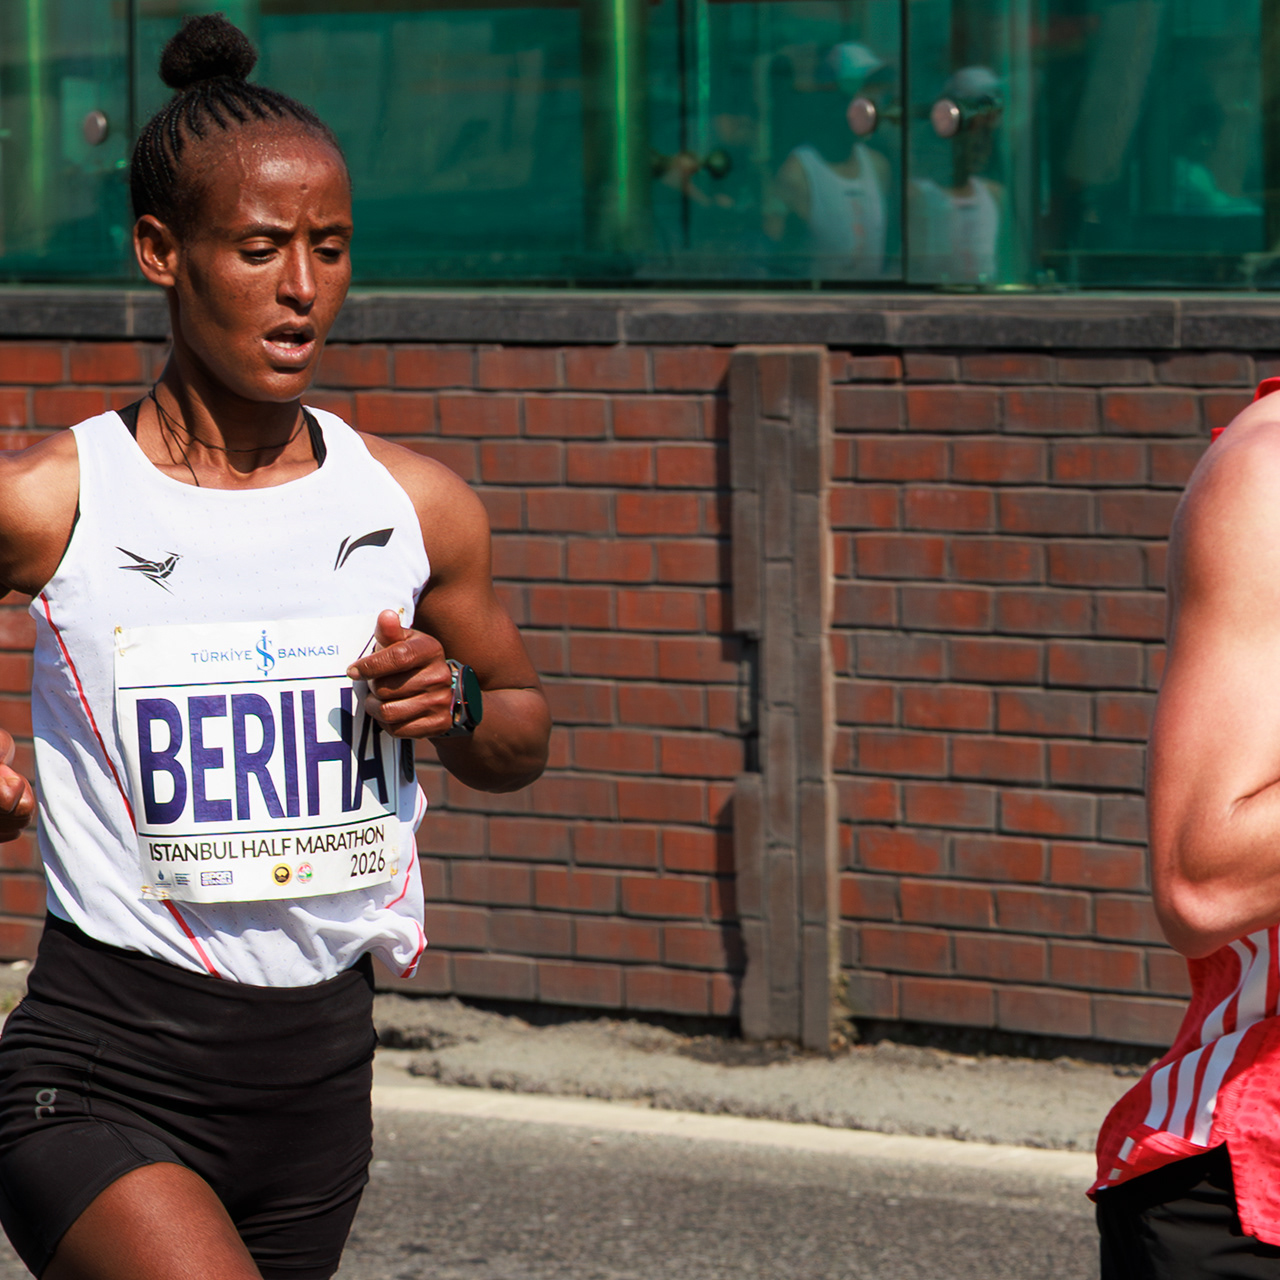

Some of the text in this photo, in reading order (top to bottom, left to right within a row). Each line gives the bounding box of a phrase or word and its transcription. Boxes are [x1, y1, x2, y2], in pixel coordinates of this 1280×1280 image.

[191, 648, 253, 663] TÜRKİYE
[278, 645, 340, 659] BANKASI
[136, 686, 389, 825] BERIHA
[149, 824, 385, 862] ISTANBUL HALF MARATHON
[350, 848, 386, 877] 2026
